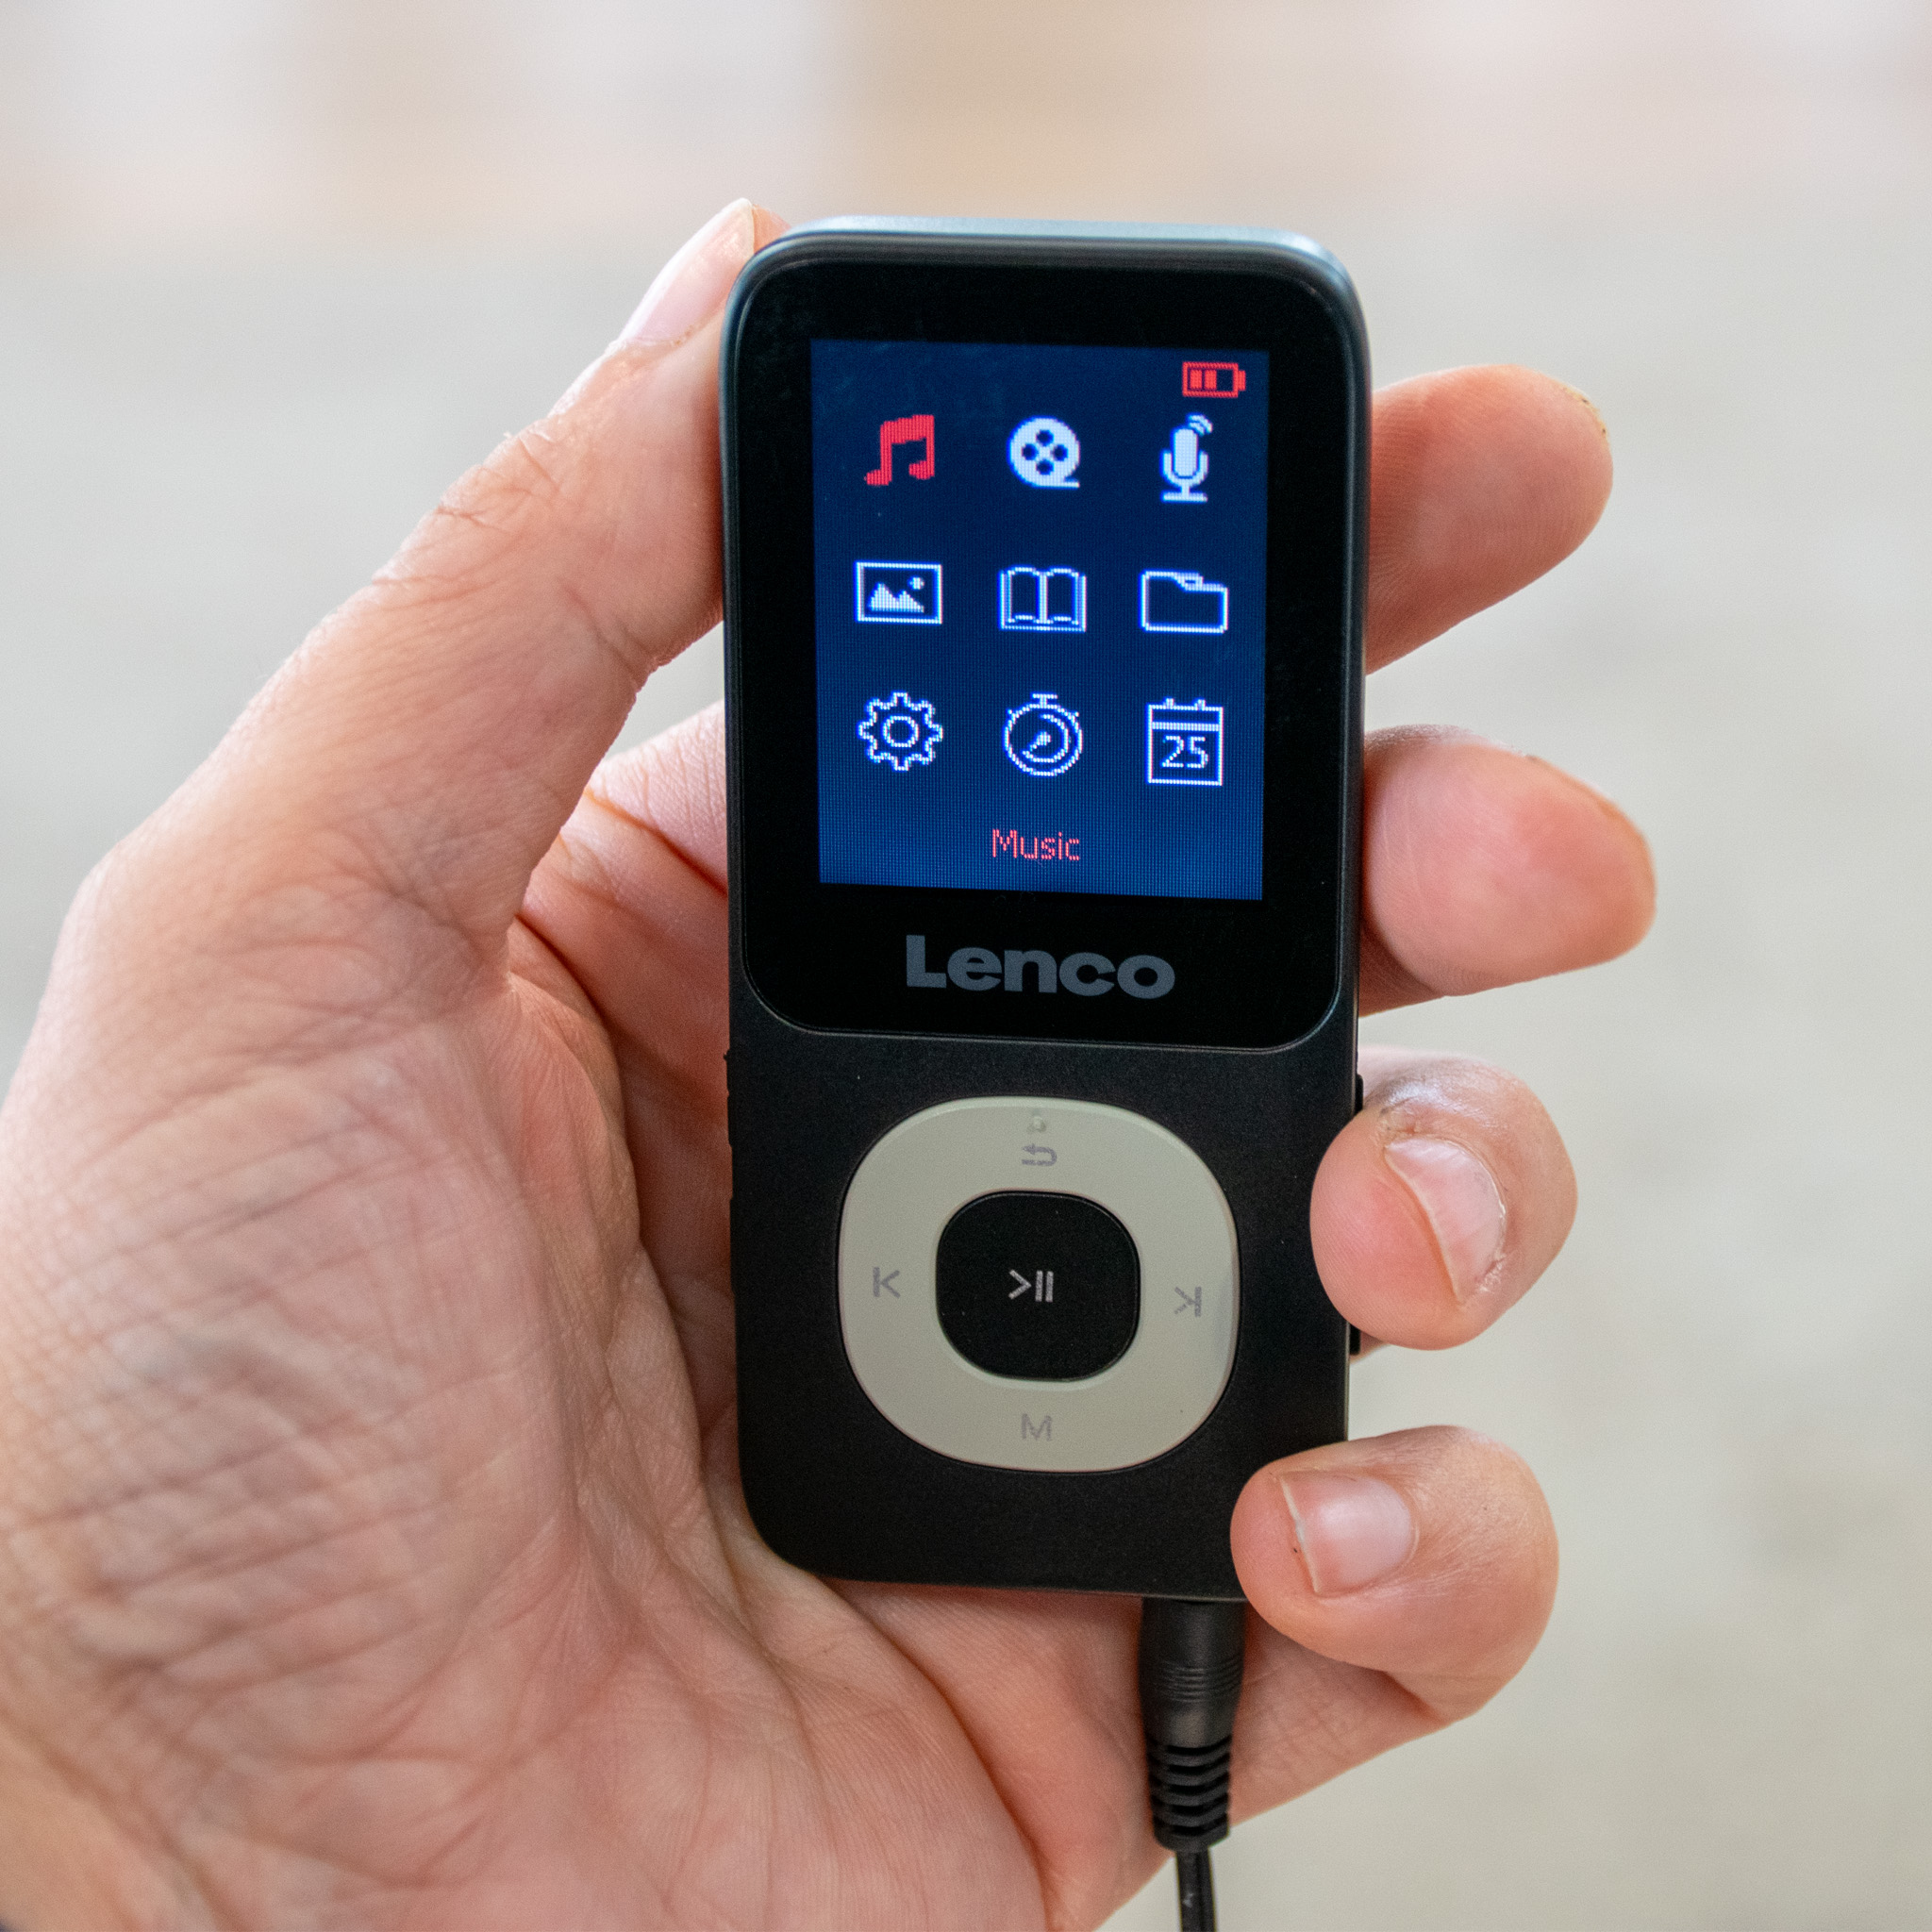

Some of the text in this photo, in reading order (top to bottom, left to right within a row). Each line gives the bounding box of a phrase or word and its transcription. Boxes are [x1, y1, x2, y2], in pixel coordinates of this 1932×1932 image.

[1160, 735, 1209, 769] 25
[991, 828, 1081, 862] Music
[906, 934, 1176, 1000] Lenco
[1021, 1413, 1054, 1441] M
